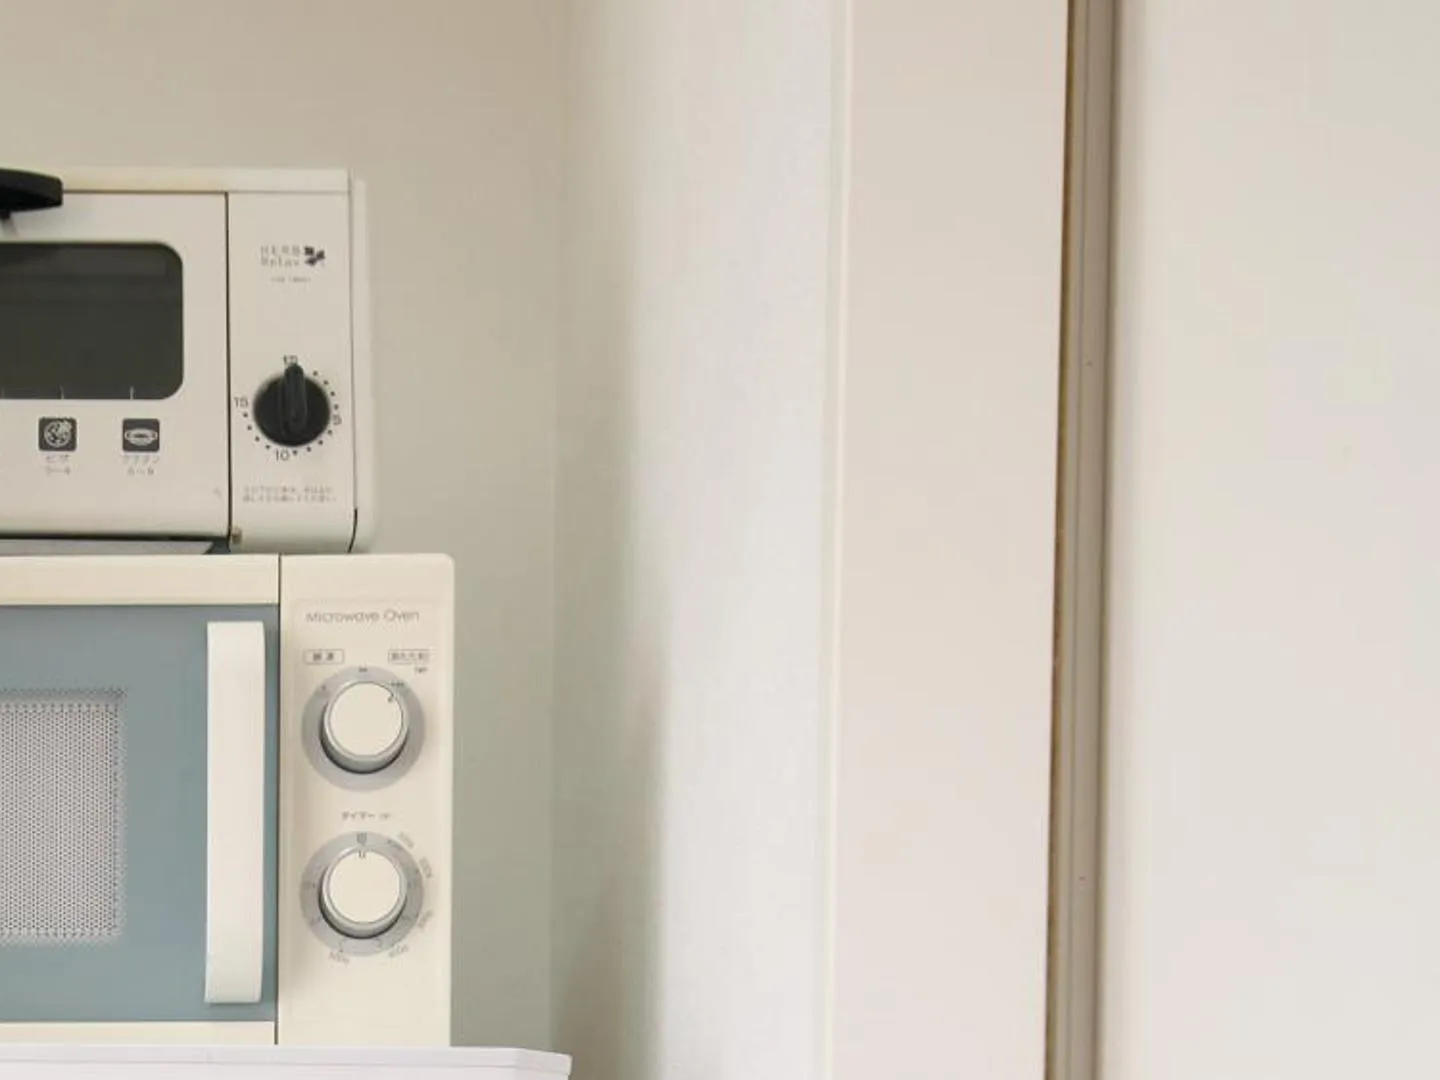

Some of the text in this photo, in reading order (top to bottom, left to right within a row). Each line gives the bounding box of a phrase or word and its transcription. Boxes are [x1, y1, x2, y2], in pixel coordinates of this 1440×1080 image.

[275, 449, 290, 461] 10
[305, 608, 420, 623] Microwave Oven
